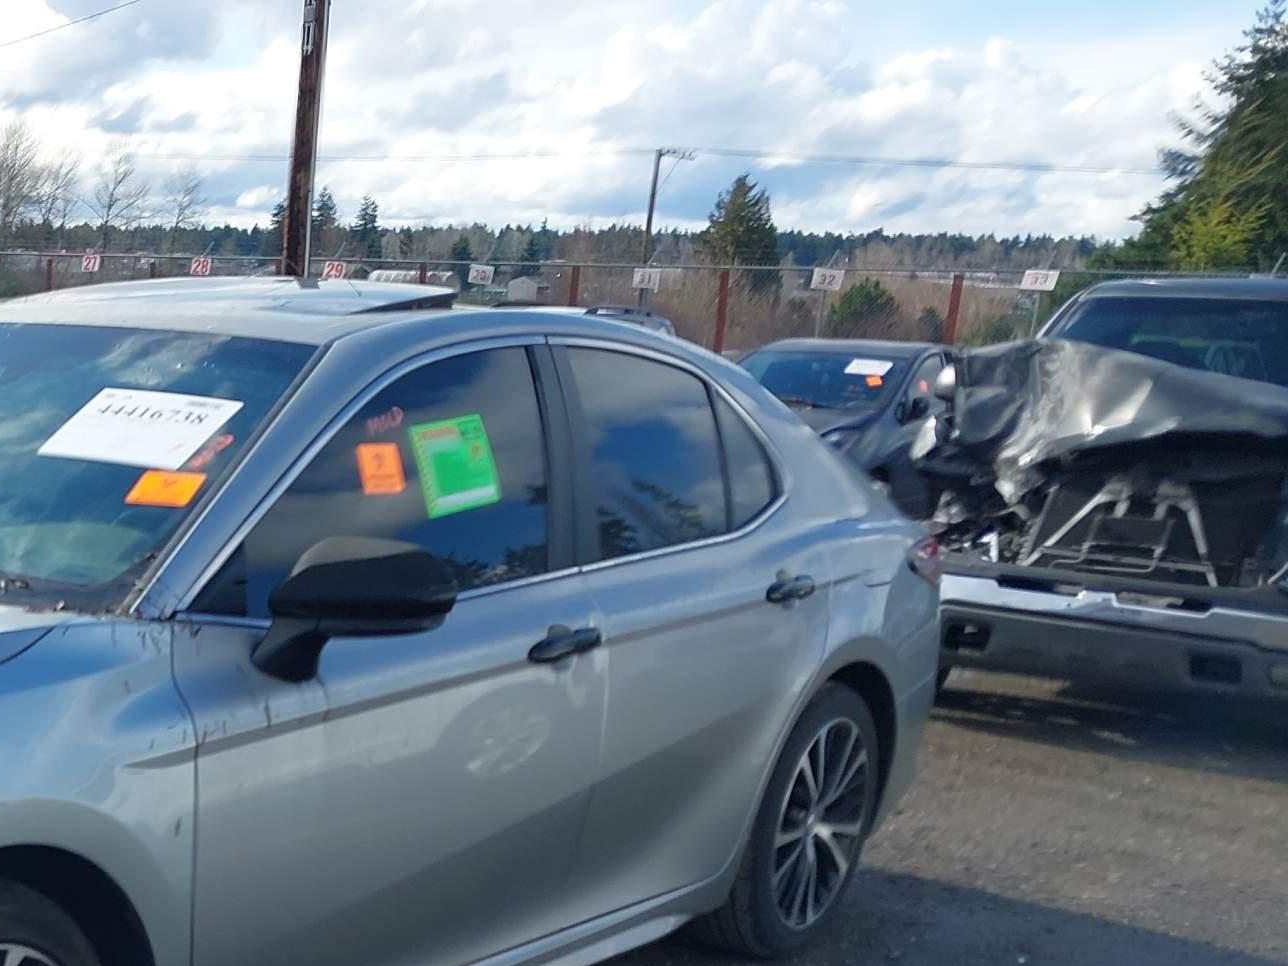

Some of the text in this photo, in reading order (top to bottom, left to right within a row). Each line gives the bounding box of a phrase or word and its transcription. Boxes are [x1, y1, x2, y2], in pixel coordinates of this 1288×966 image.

[84, 255, 98, 271] 27
[193, 258, 209, 274] 28
[326, 262, 344, 278] 29
[819, 274, 836, 287] 32
[97, 403, 208, 425] 44416738
